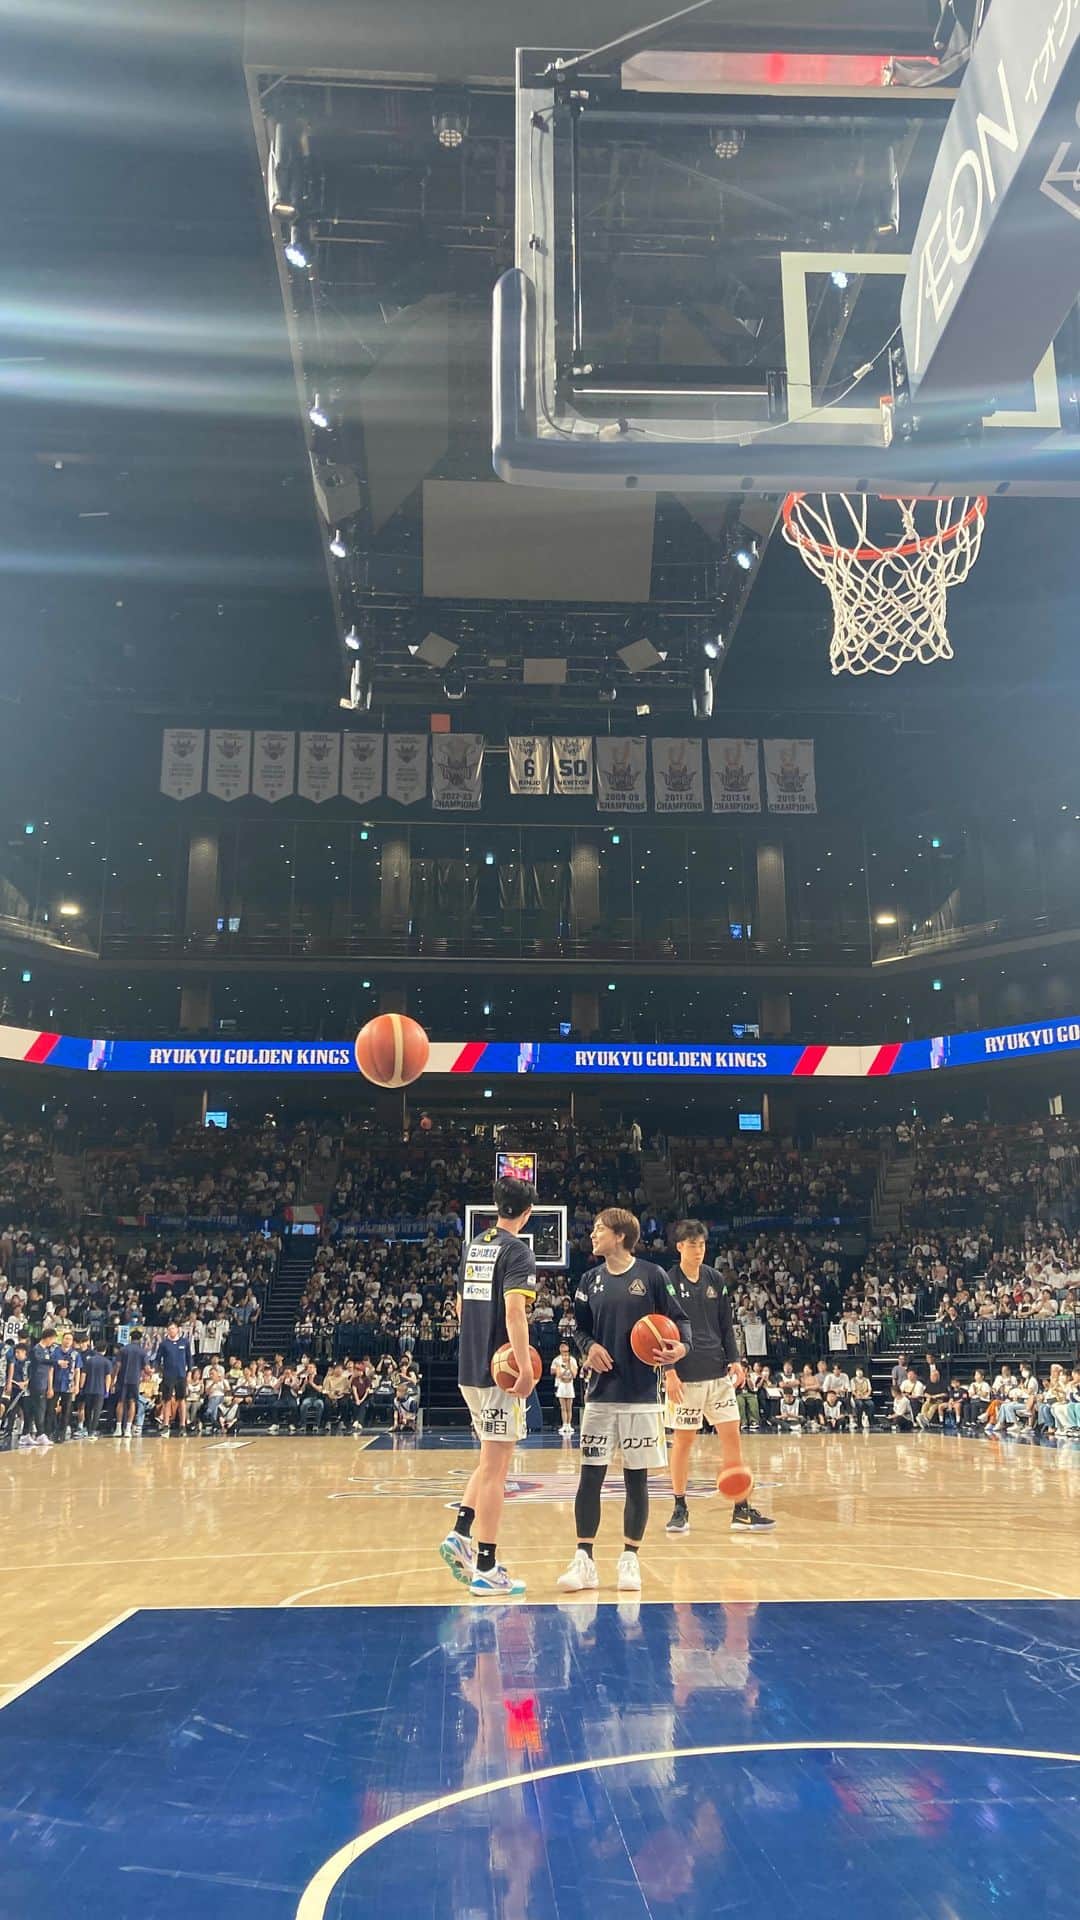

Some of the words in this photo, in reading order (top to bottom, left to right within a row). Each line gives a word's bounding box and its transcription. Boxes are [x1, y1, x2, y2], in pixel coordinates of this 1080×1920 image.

[524, 759, 535, 777] 6
[559, 759, 588, 777] 50
[599, 801, 645, 810] CHAMPIONS
[656, 802, 703, 810] CHAMPIONS
[714, 802, 759, 810] CHAMPIONS
[768, 803, 816, 811] CHAMPIONS
[985, 1028, 1053, 1053] RYUKYU
[149, 1048, 221, 1064] RYUKYU
[224, 1048, 293, 1065] GOLDEN
[296, 1048, 350, 1065] KINGS
[575, 1050, 644, 1067] RYUKYU
[646, 1051, 713, 1067] GOLDEN
[715, 1052, 768, 1068] KINGS
